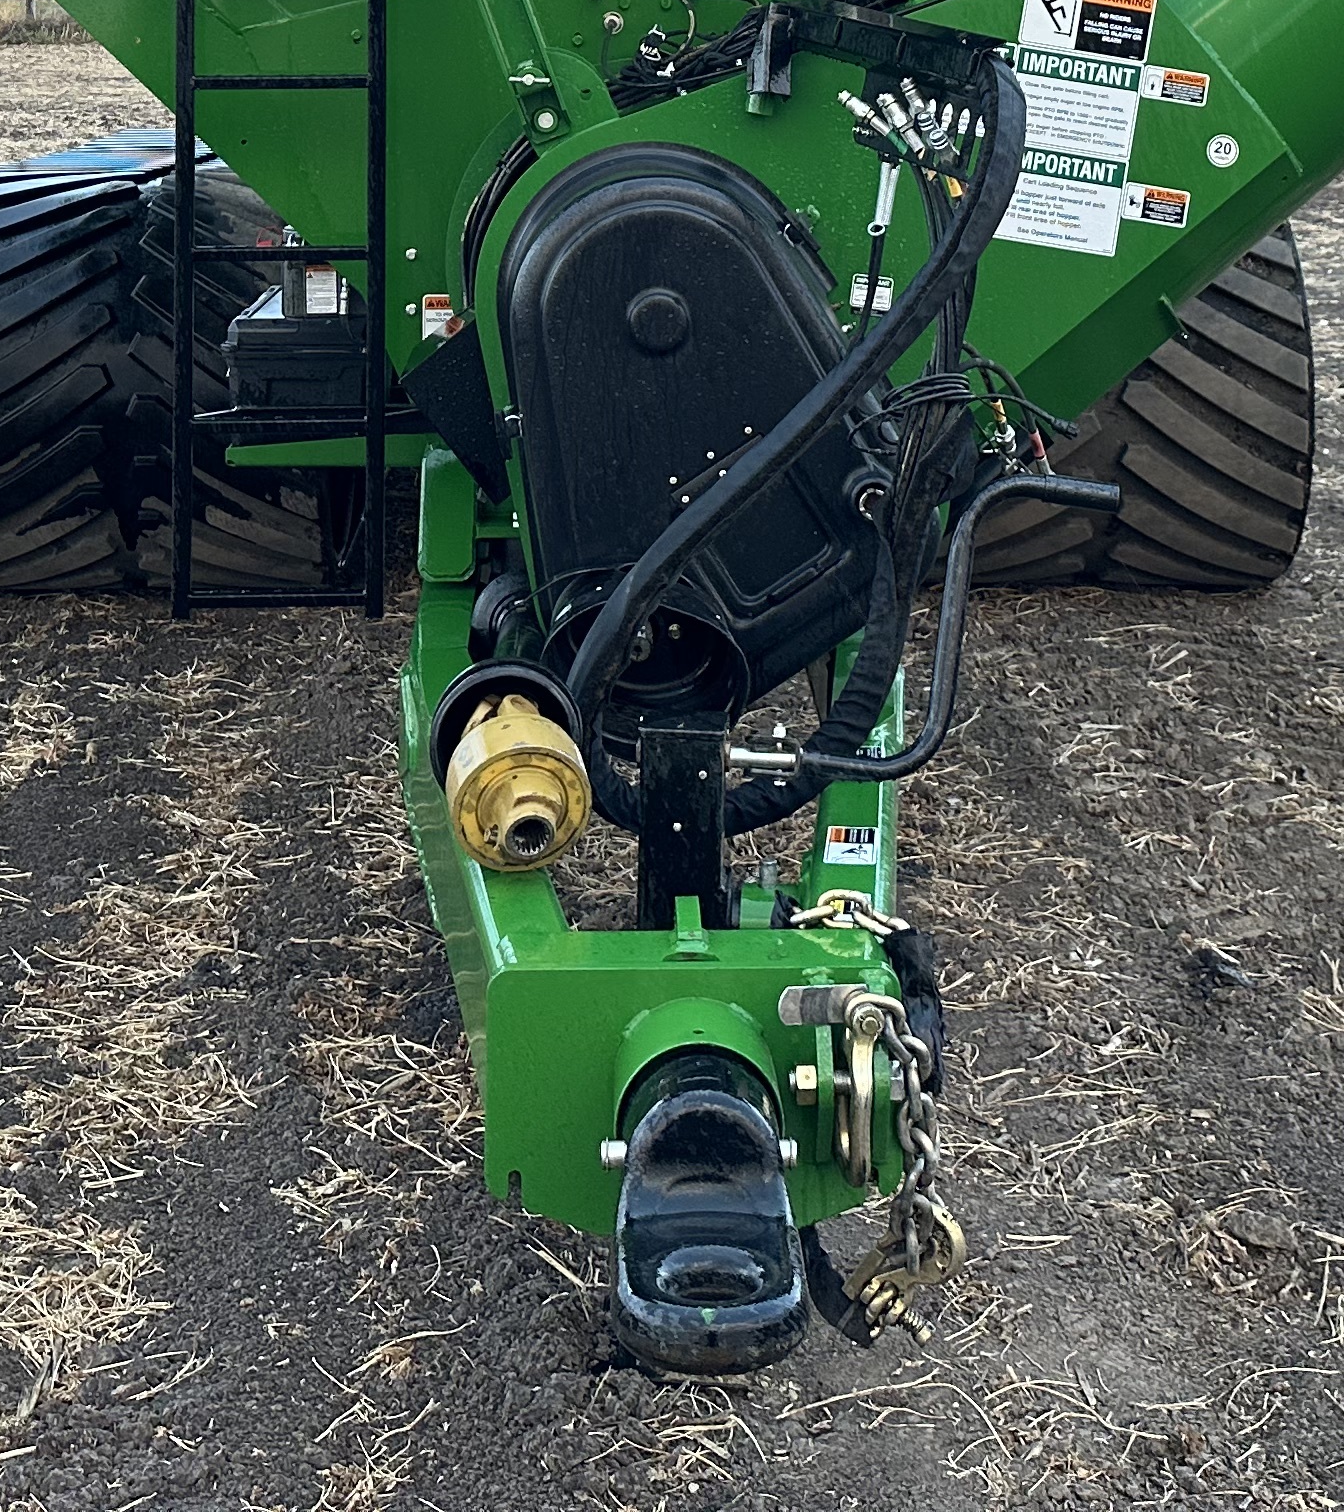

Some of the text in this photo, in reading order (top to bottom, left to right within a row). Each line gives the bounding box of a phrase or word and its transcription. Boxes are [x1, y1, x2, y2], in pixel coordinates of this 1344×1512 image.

[1021, 51, 1136, 88] IMPORTANT
[1213, 141, 1232, 155] 20
[1021, 150, 1118, 183] MPORTANT
